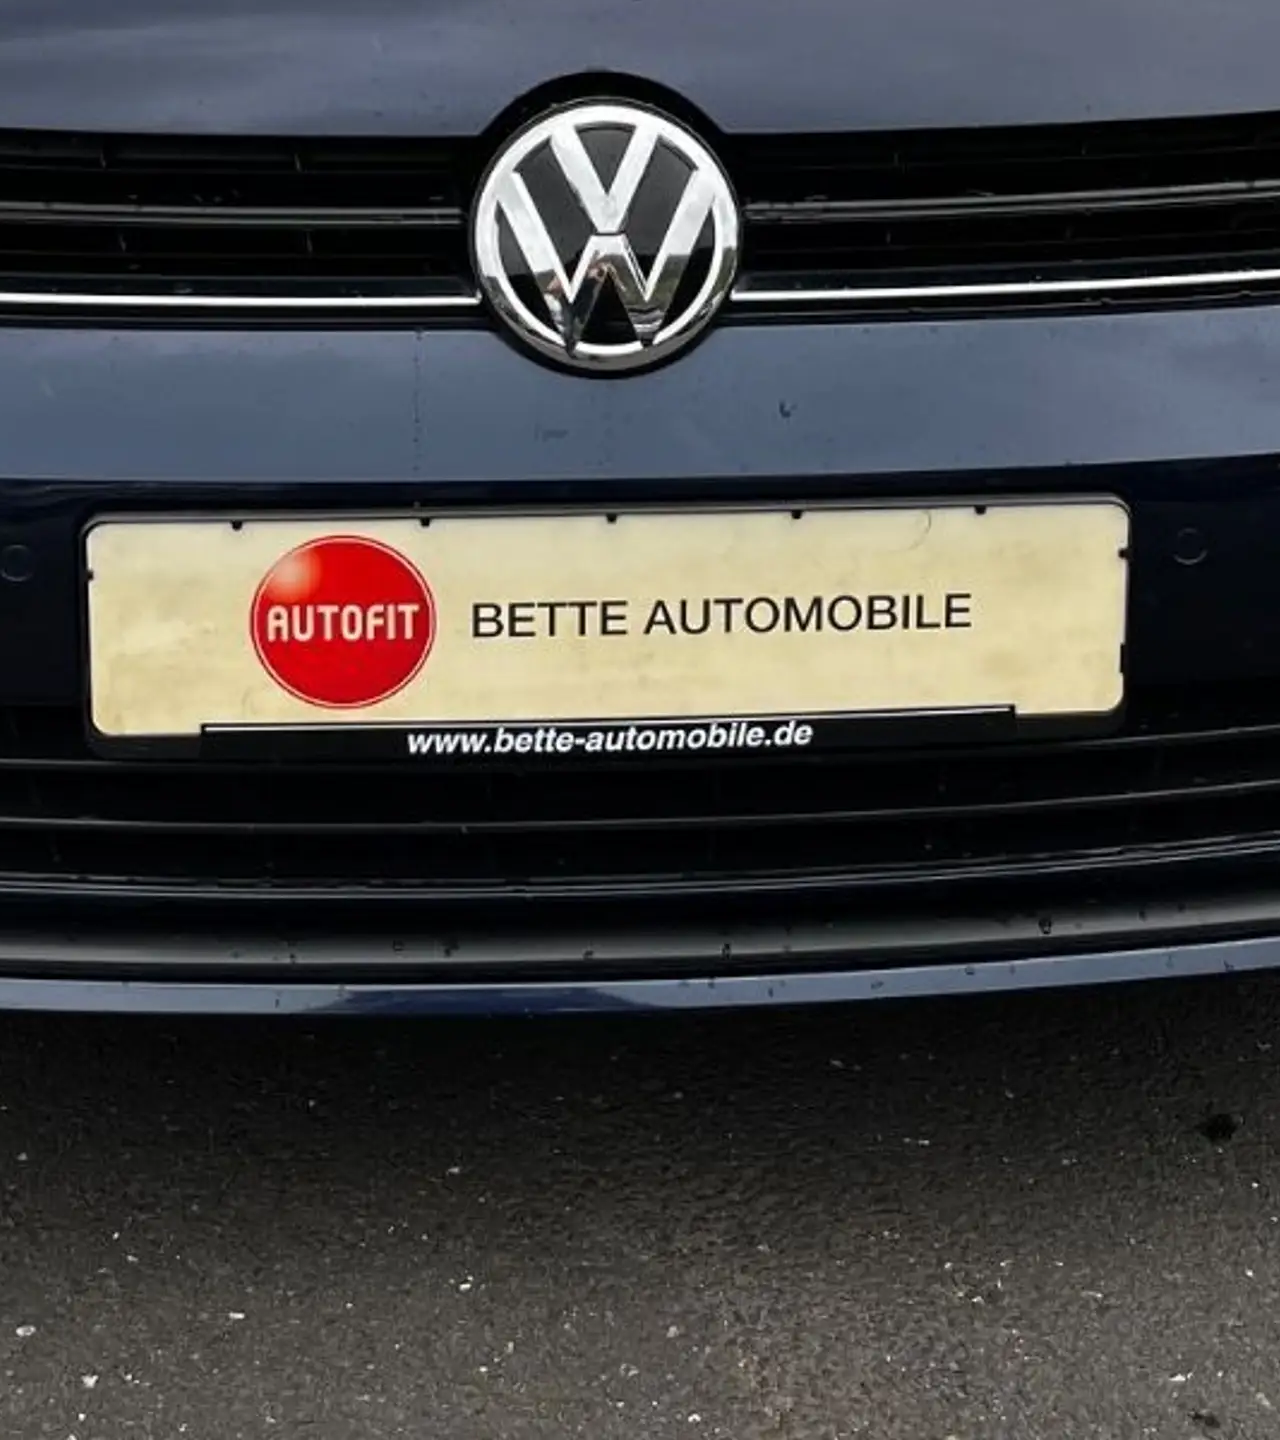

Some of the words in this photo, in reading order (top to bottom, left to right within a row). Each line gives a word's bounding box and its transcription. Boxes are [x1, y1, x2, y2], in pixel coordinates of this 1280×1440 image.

[267, 604, 420, 642] AUTOFIT
[472, 600, 628, 638] BETTE
[643, 593, 972, 636] AUTOMOBILE
[407, 720, 814, 754] www.bette-automobile.de
